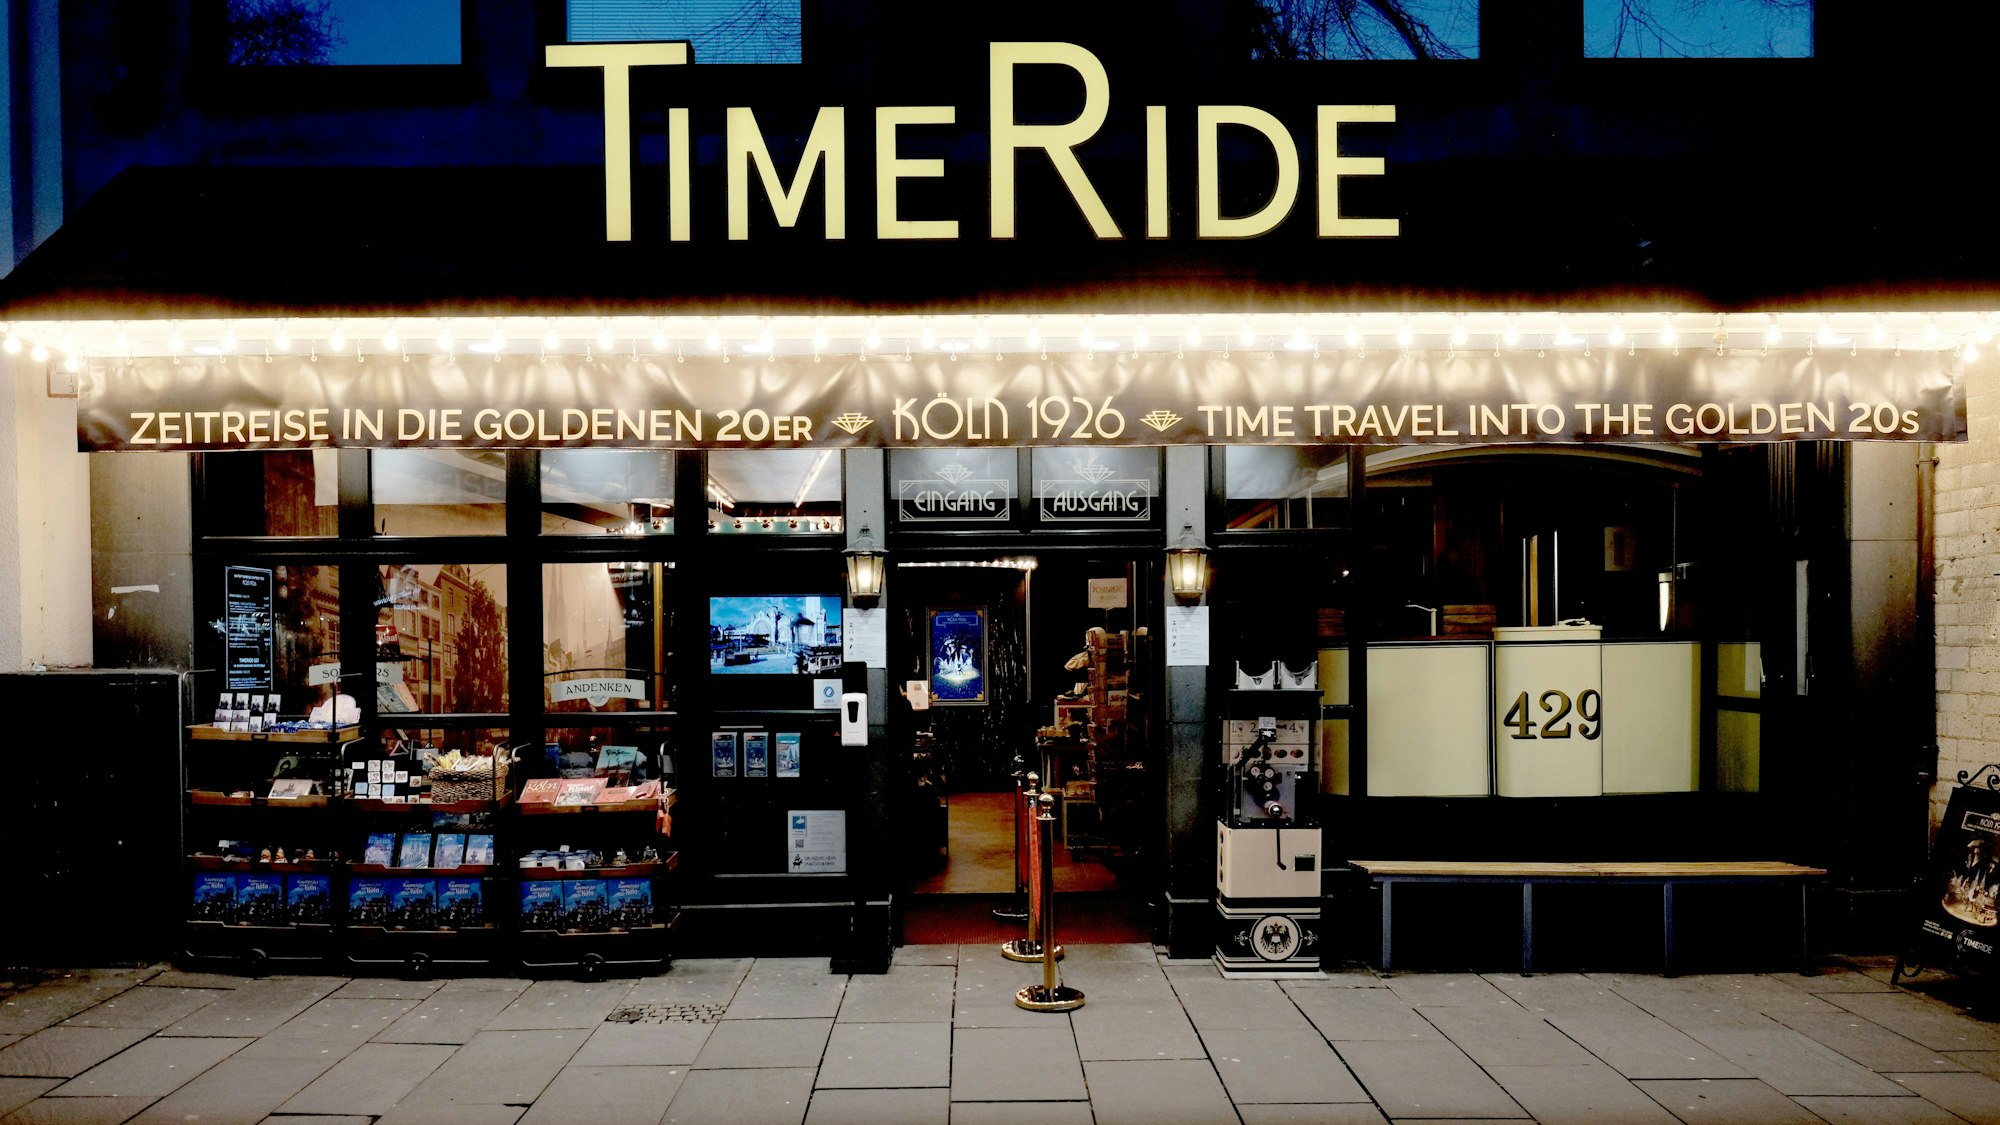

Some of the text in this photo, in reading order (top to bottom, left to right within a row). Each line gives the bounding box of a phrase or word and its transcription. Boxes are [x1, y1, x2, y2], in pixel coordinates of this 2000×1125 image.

[130, 408, 329, 445] ZEITREISE
[342, 408, 383, 441] IN
[397, 408, 463, 441] DIE
[473, 408, 703, 441] GOLDENEN
[892, 392, 1009, 440] KÖLN
[1026, 395, 1125, 439] 1926
[1197, 405, 1296, 437] TIME
[1304, 404, 1459, 437] TRAVEL
[1469, 403, 1565, 436] INTO
[1575, 403, 1654, 435] THE
[1665, 401, 1836, 435] GOLDEN
[914, 490, 995, 512] EINGANG
[1053, 490, 1139, 512] AUSGANG
[566, 682, 632, 695] ANDENKEN
[1503, 689, 1601, 740] 429
[1963, 936, 1994, 954] TIMERIDE
